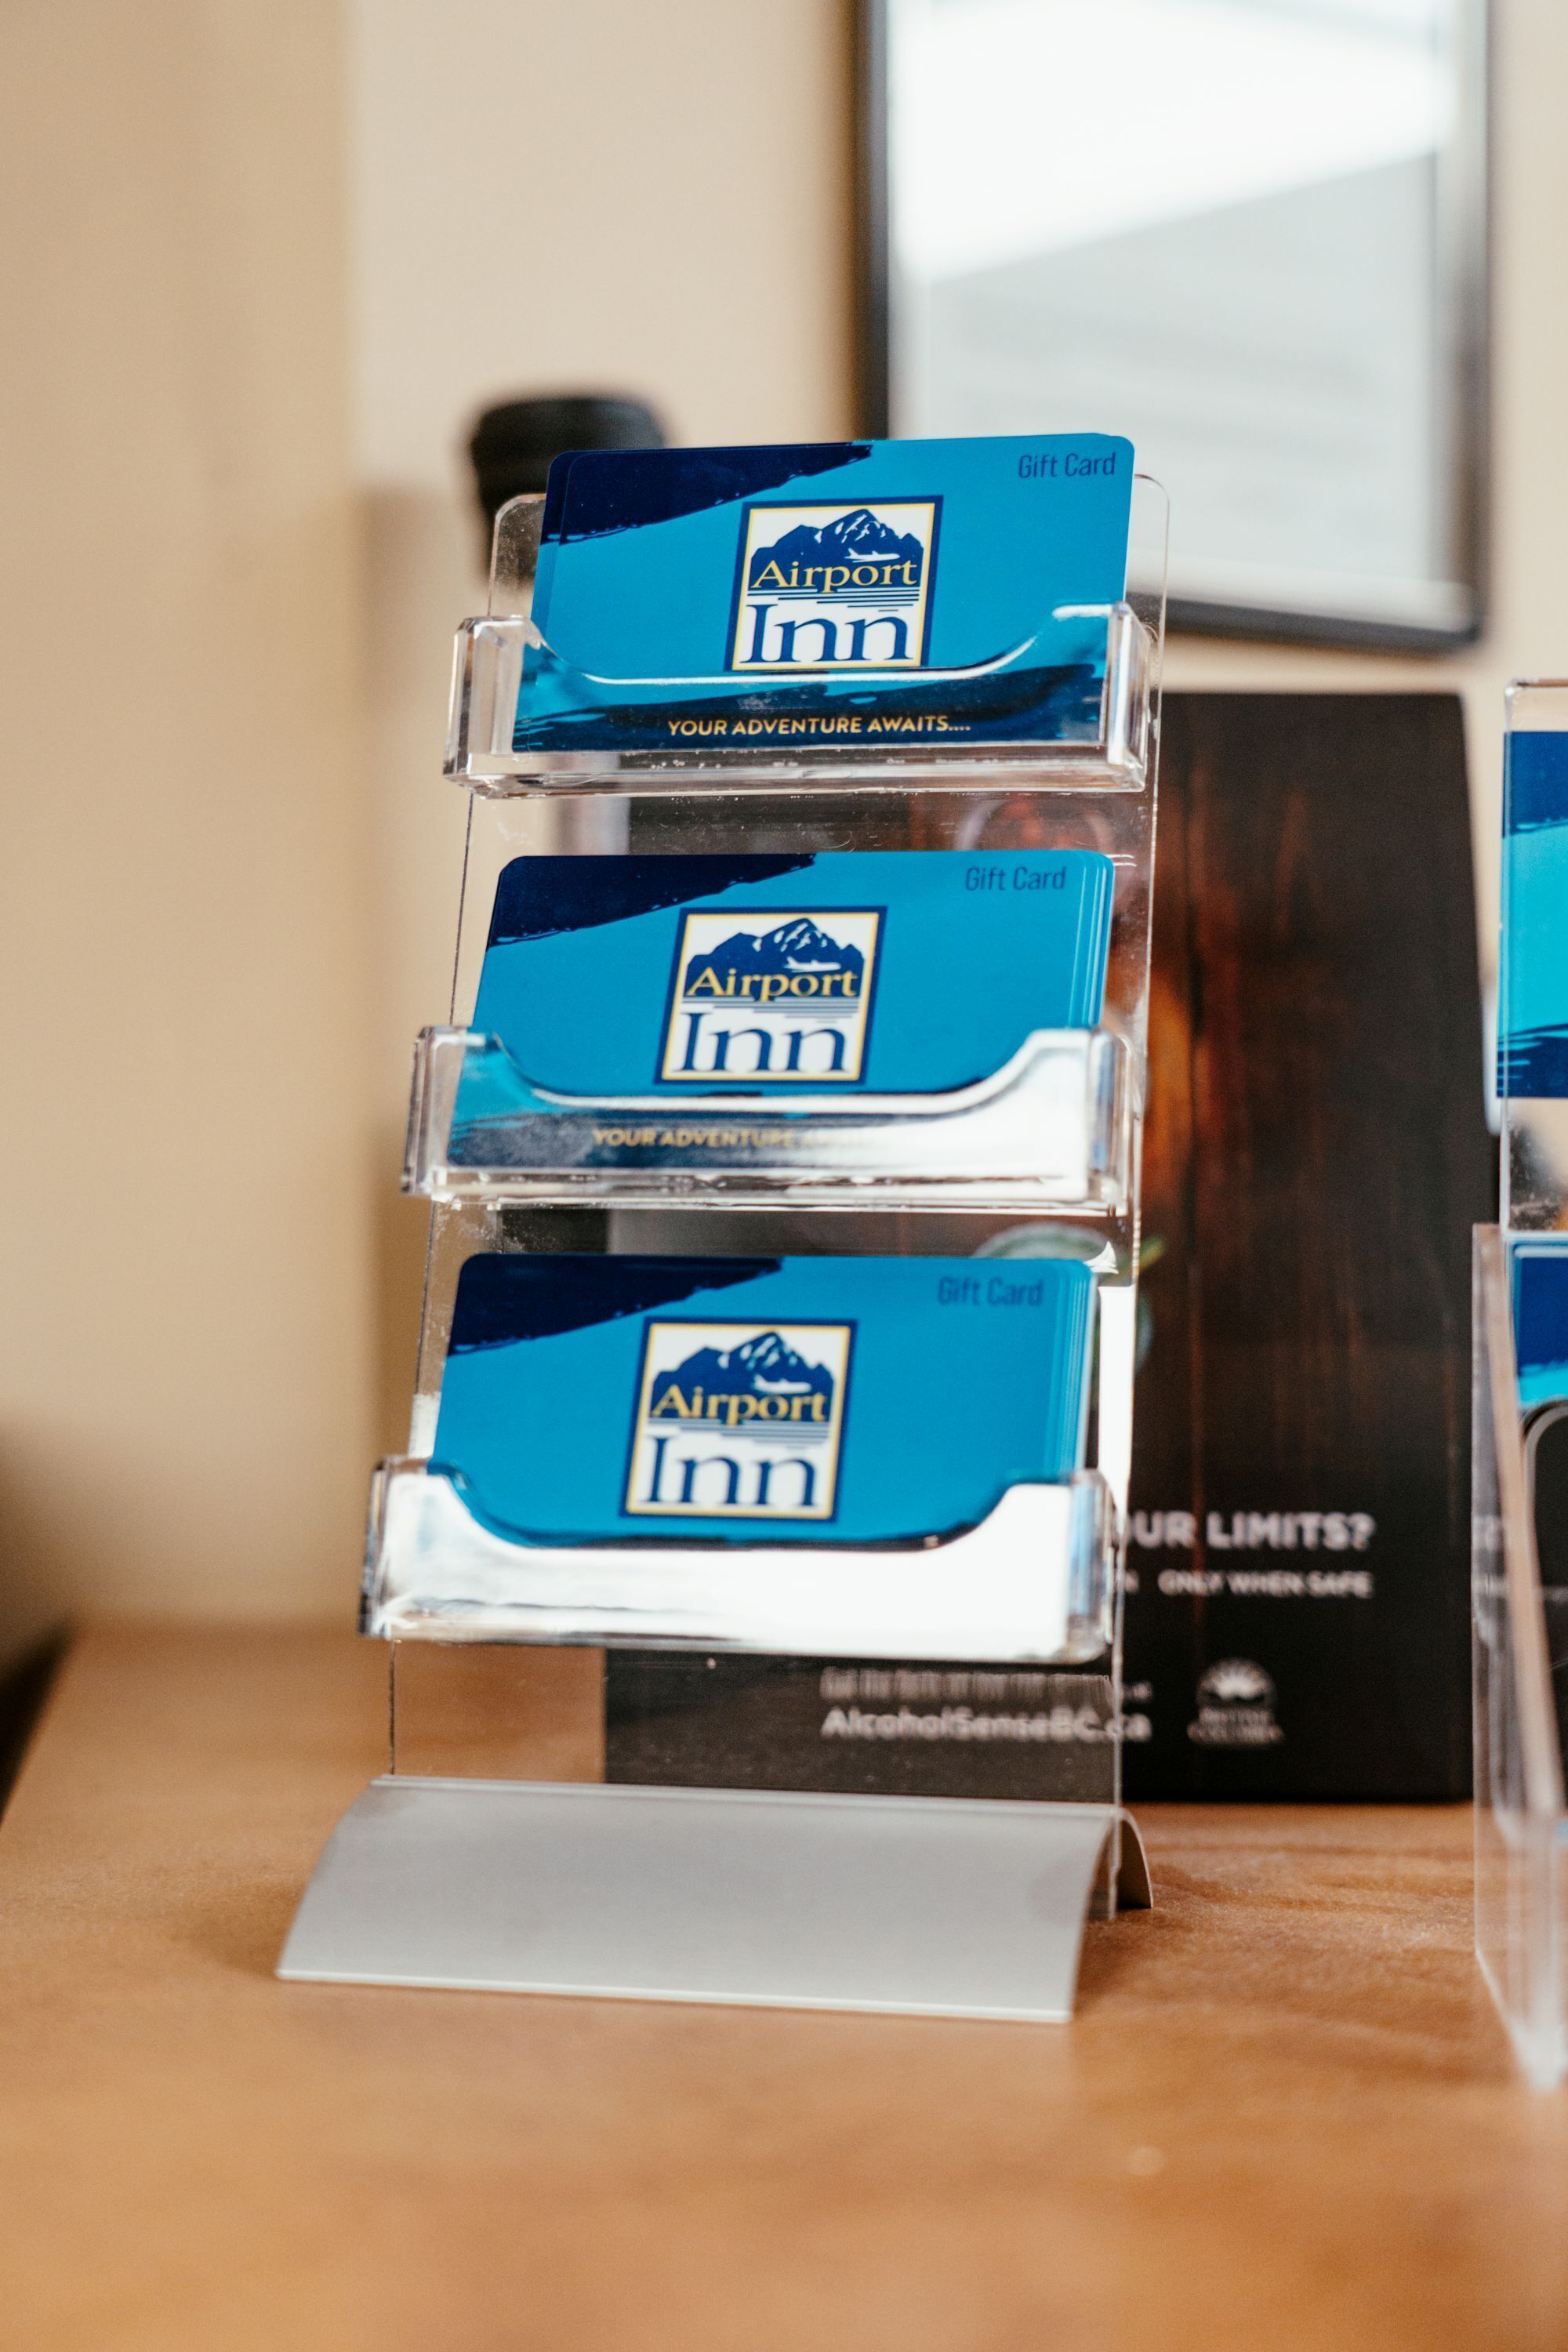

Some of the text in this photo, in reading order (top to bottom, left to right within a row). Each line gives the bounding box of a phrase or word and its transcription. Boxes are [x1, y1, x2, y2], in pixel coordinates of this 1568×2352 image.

[1018, 452, 1116, 478] Gift Card
[750, 560, 917, 593] Airport
[739, 604, 914, 663] Inn
[668, 720, 728, 736] YOUR
[731, 717, 863, 735] ADVENTURE
[965, 866, 1067, 891] Gift Card
[685, 967, 858, 1003] Airport
[672, 1012, 851, 1073] Inn
[593, 1128, 655, 1147] YOUR
[659, 1128, 793, 1148] ADVENTURE
[938, 1276, 1044, 1306] Gift Card
[650, 1384, 827, 1427] Airport
[640, 1434, 817, 1508] Inn
[1127, 1510, 1376, 1551] UR LIMITS?
[1157, 1569, 1225, 1596] ONLY
[1226, 1570, 1305, 1597] WHEN
[1306, 1570, 1373, 1599] SAFE
